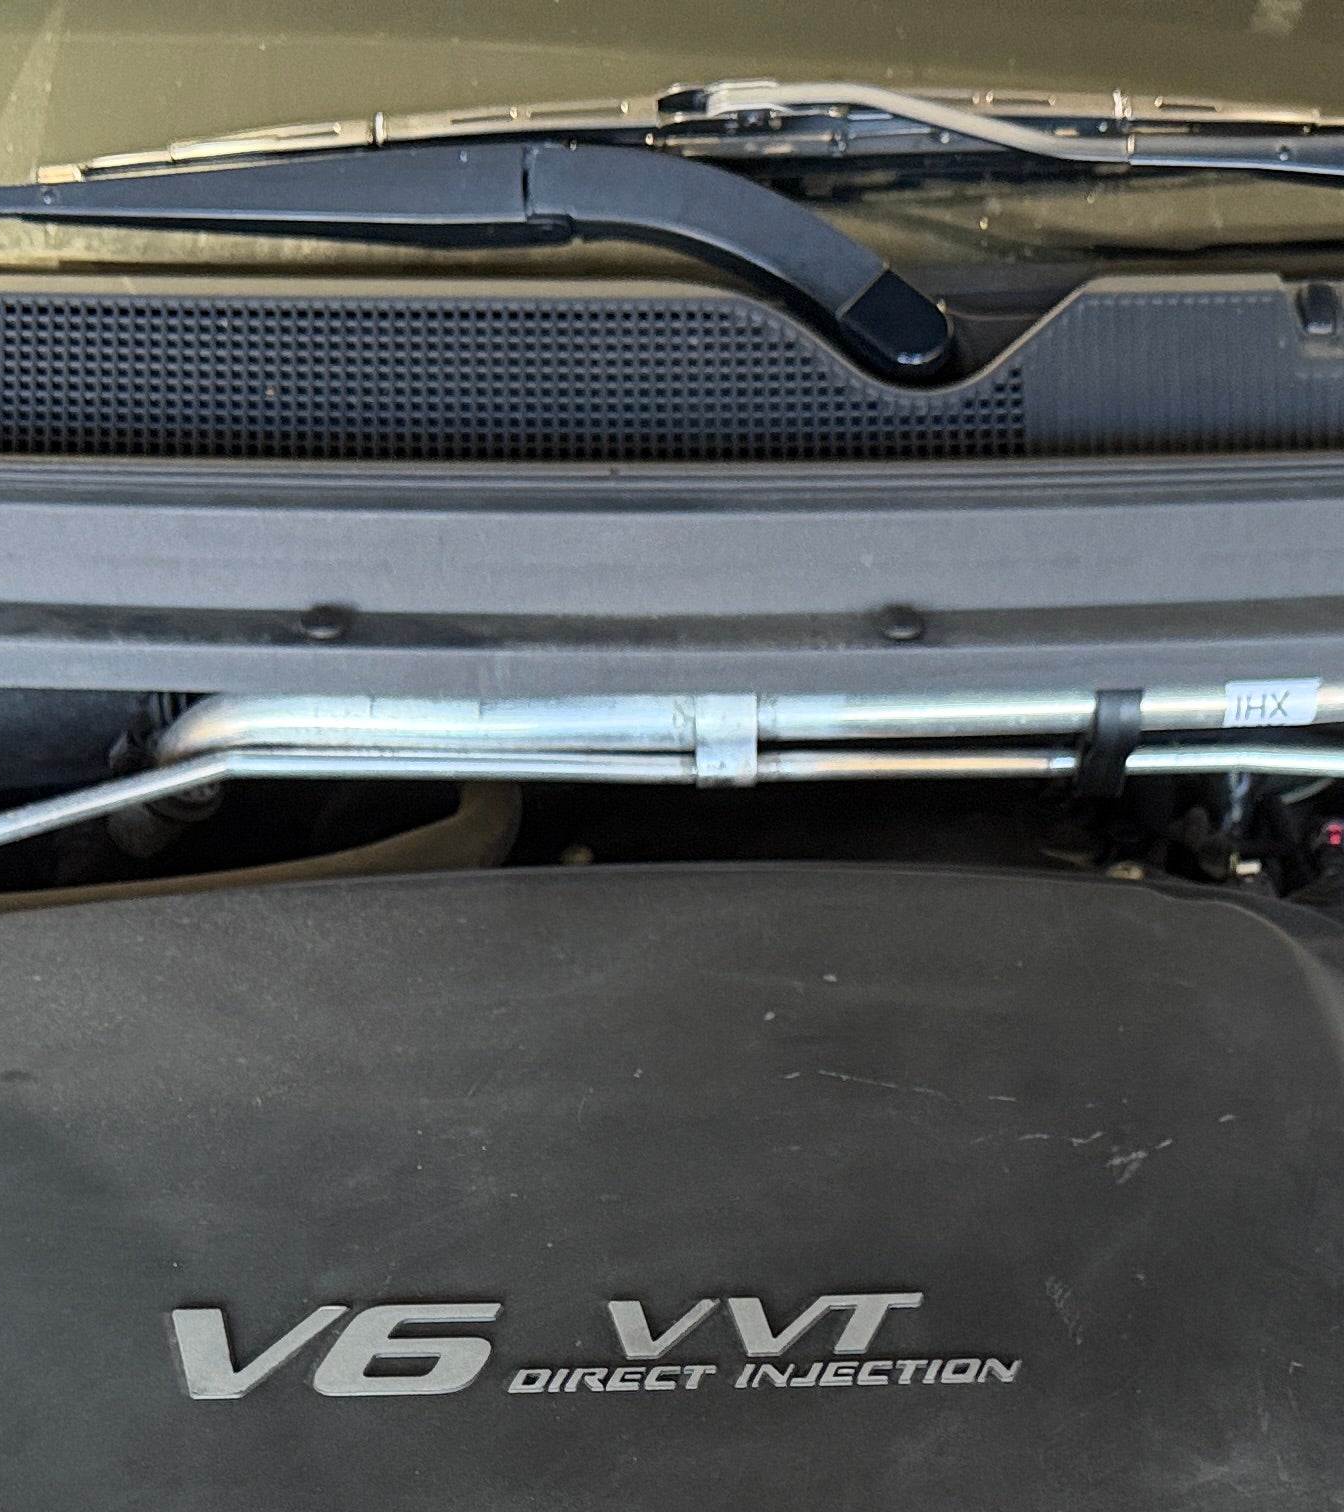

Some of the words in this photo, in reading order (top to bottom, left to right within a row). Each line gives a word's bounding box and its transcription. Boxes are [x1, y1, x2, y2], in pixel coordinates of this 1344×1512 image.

[1235, 690, 1290, 721] IHX
[172, 1303, 502, 1400] V6
[608, 1292, 924, 1361] VVT
[507, 1364, 717, 1393] DIRECT
[733, 1357, 1023, 1389] INJECTION
